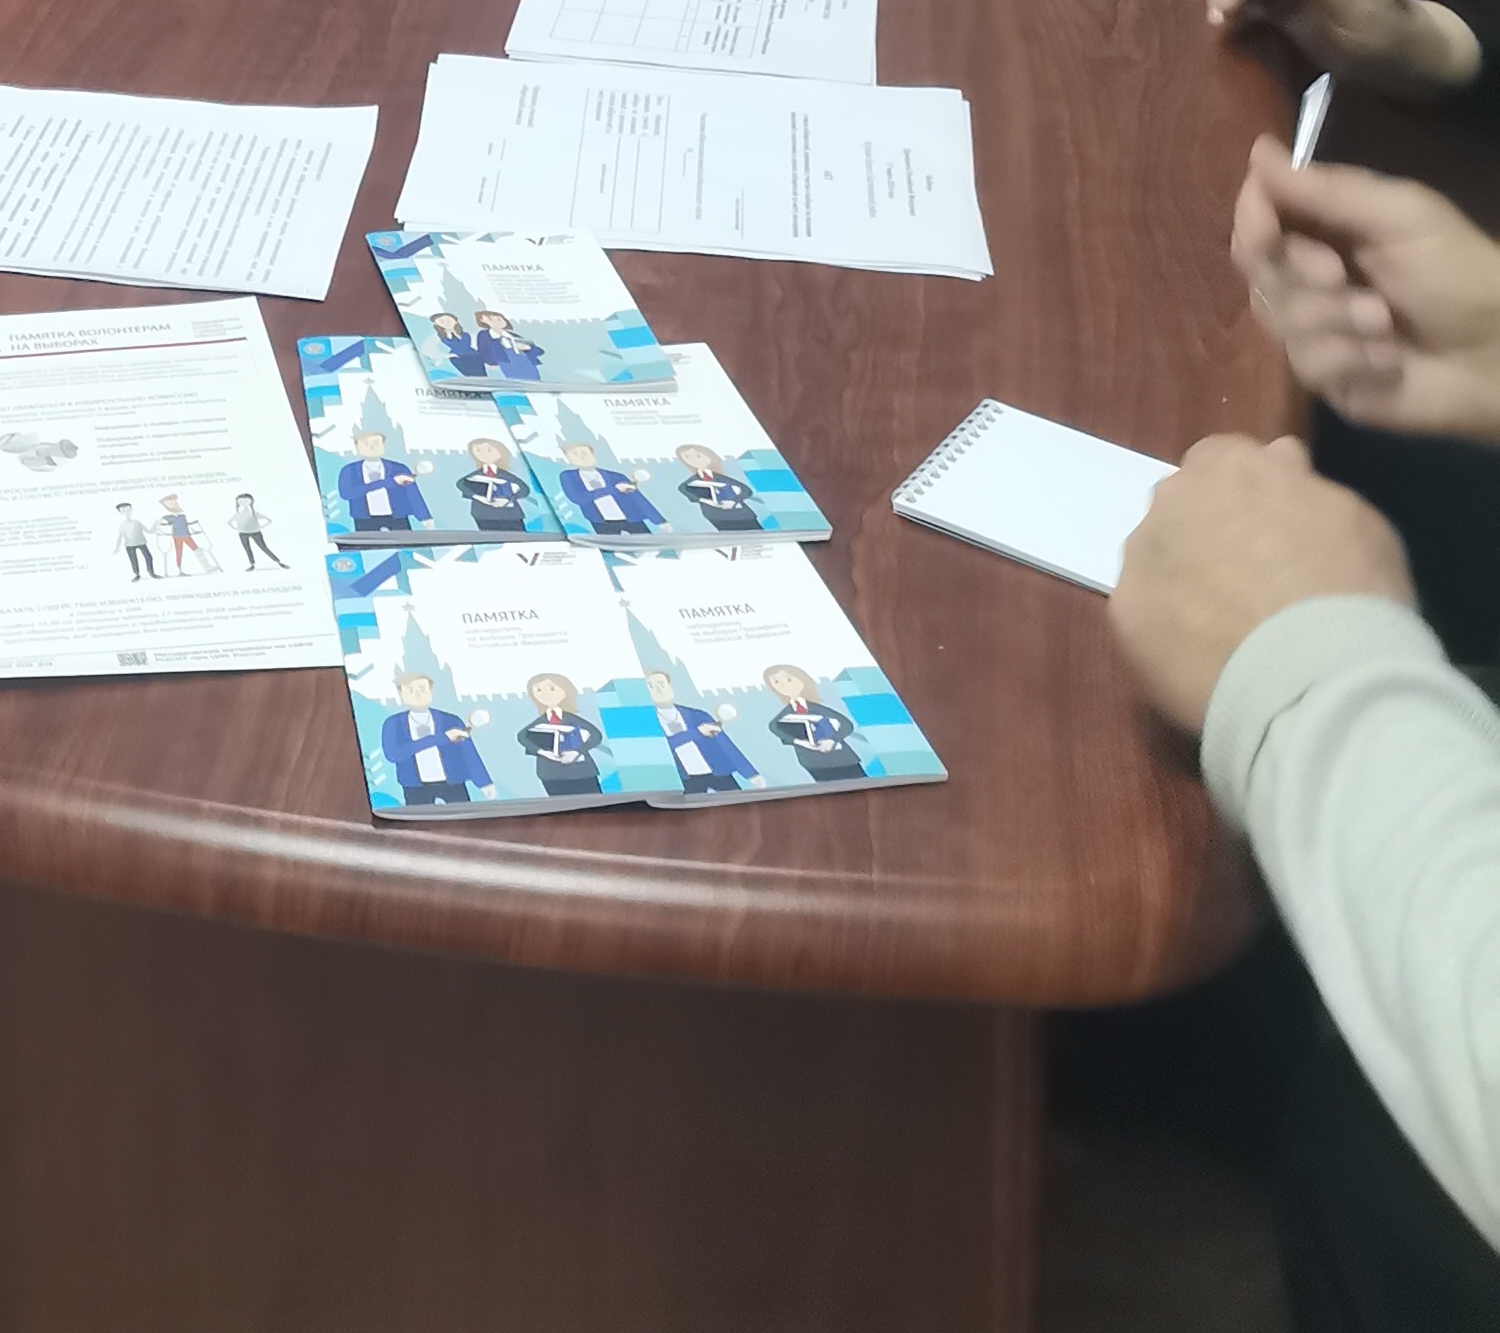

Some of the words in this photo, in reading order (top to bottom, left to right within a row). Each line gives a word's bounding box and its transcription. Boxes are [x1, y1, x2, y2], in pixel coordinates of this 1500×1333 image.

[481, 262, 545, 272] ПАМЯТКА
[8, 328, 75, 341] ПАМЯТКА
[78, 323, 172, 337] ВОЛОНТЕРАМ
[10, 341, 31, 351] НА
[33, 337, 99, 350] ВЫБОРАХ
[603, 397, 672, 407] ПАМЯТКА
[462, 608, 540, 624] ПАМЯТКА
[678, 602, 756, 619] ПАМЯТКА
